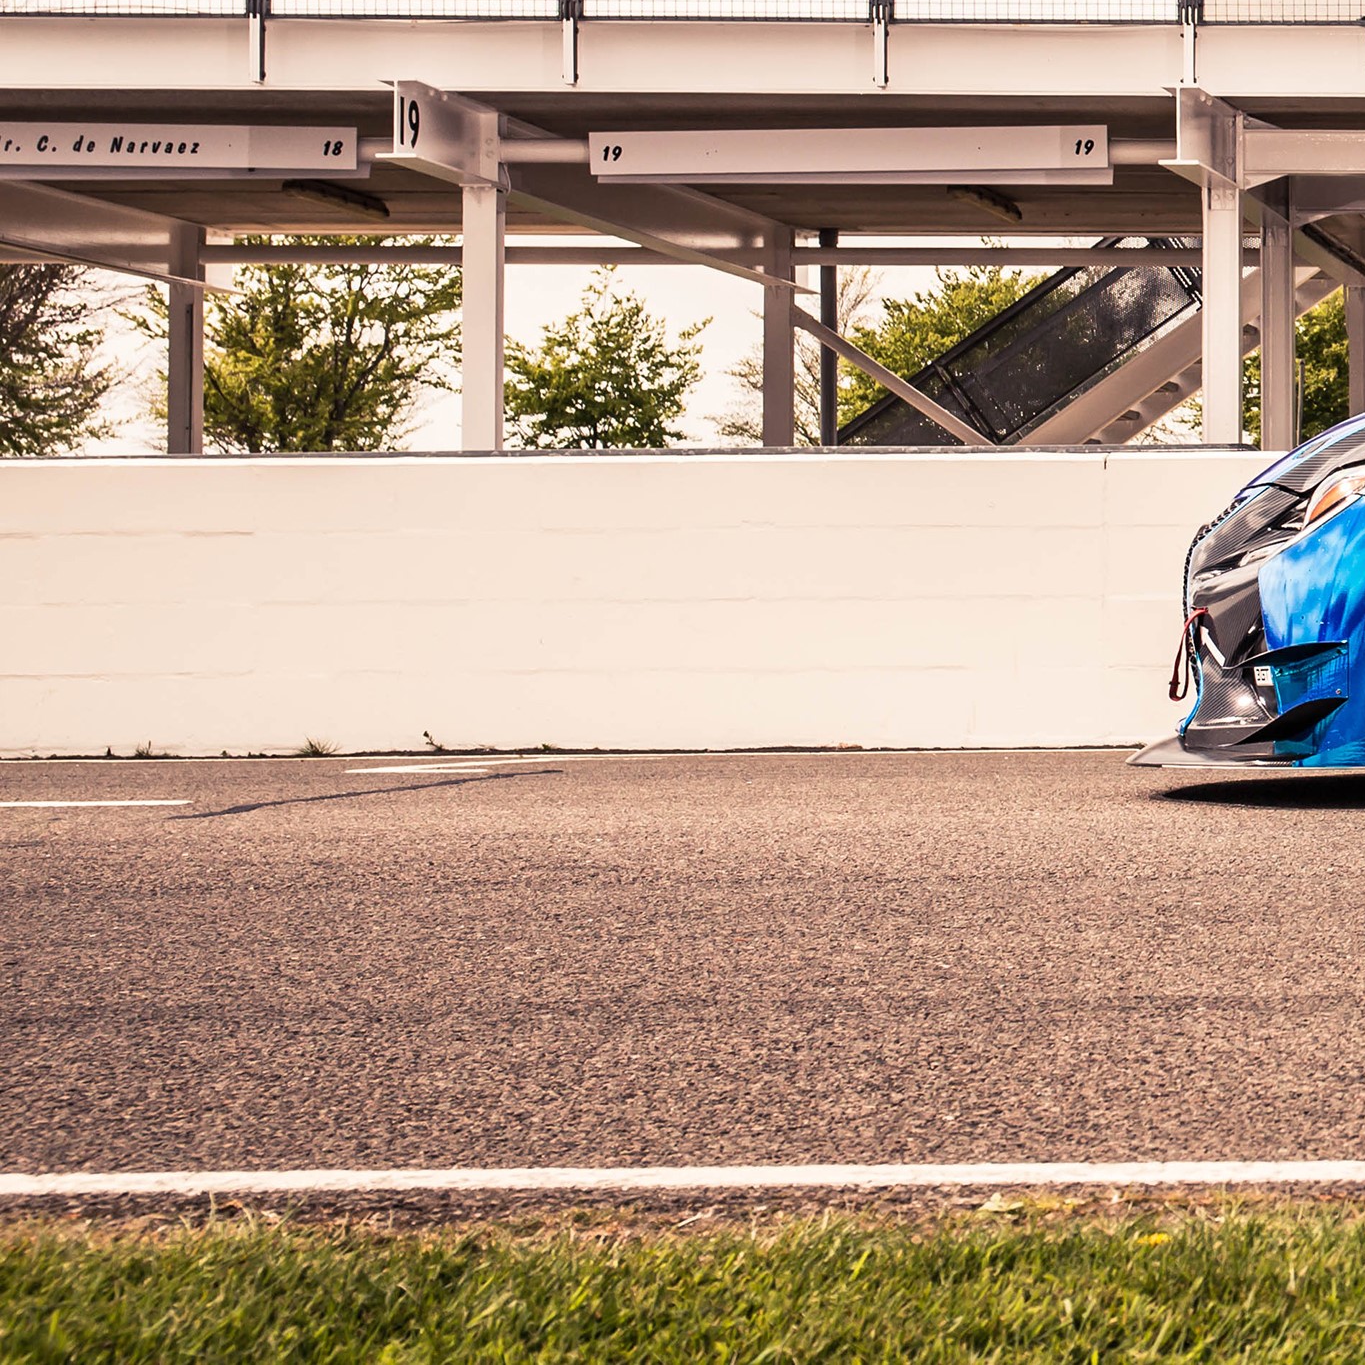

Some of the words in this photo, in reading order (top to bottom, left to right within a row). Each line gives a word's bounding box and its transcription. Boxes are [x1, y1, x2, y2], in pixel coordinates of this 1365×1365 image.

[400, 96, 420, 148] 19
[0, 137, 21, 152] r.
[36, 135, 57, 152] C.
[72, 135, 96, 153] de
[110, 136, 200, 154] Narvaez
[323, 140, 344, 156] 18
[1075, 139, 1095, 156] 19
[603, 145, 623, 162] 19
